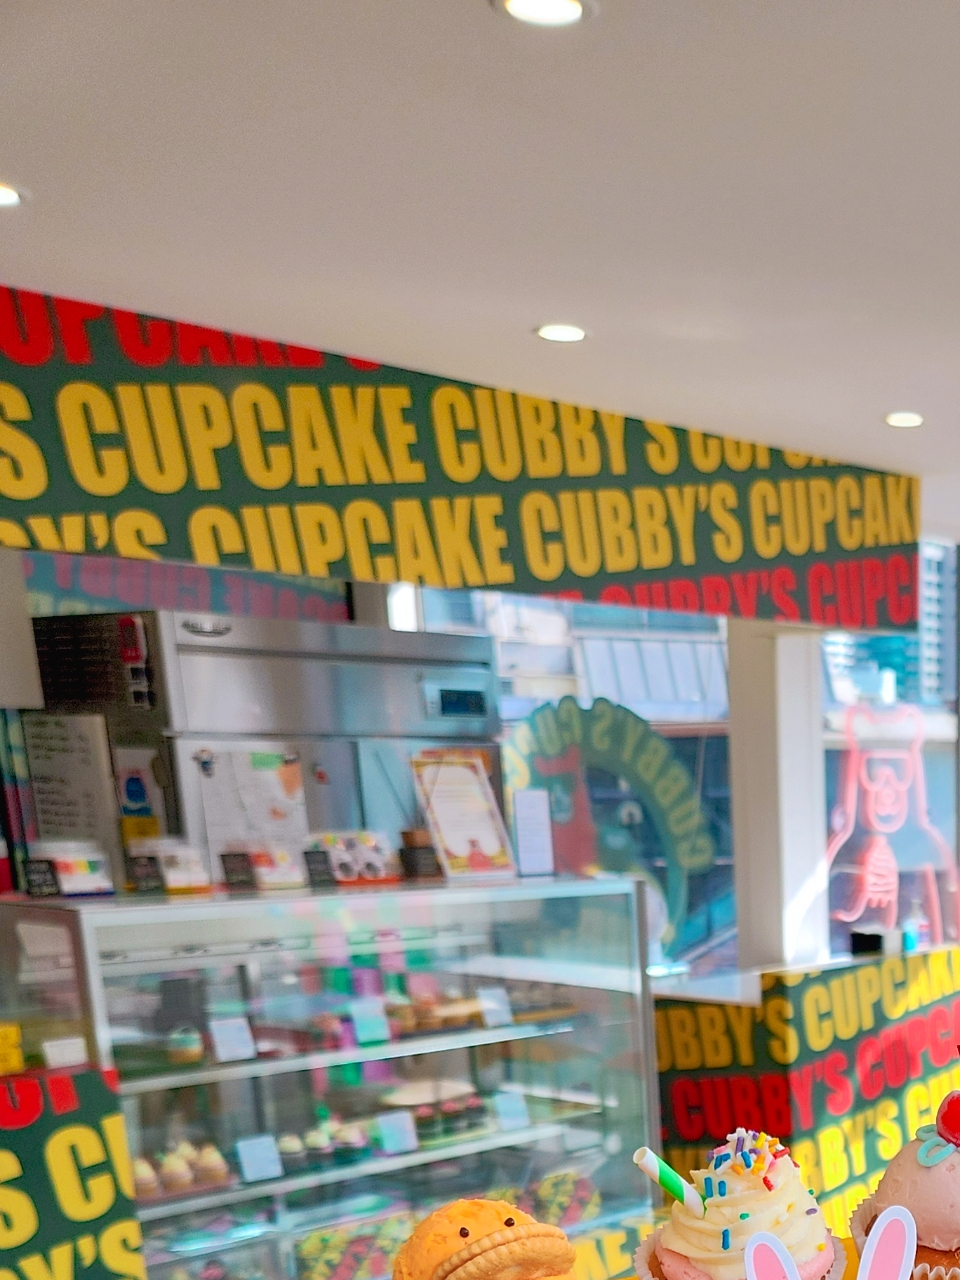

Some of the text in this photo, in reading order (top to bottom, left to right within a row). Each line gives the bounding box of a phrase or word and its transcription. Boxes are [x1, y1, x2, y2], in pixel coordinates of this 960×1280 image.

[56, 382, 426, 497] CUPCAKE
[430, 384, 680, 483] CUBBYS
[519, 481, 744, 582] CUBBY'S
[749, 475, 919, 559] CUPCAK
[807, 553, 918, 630] CUPC
[671, 1051, 854, 1142] CUBBY'S
